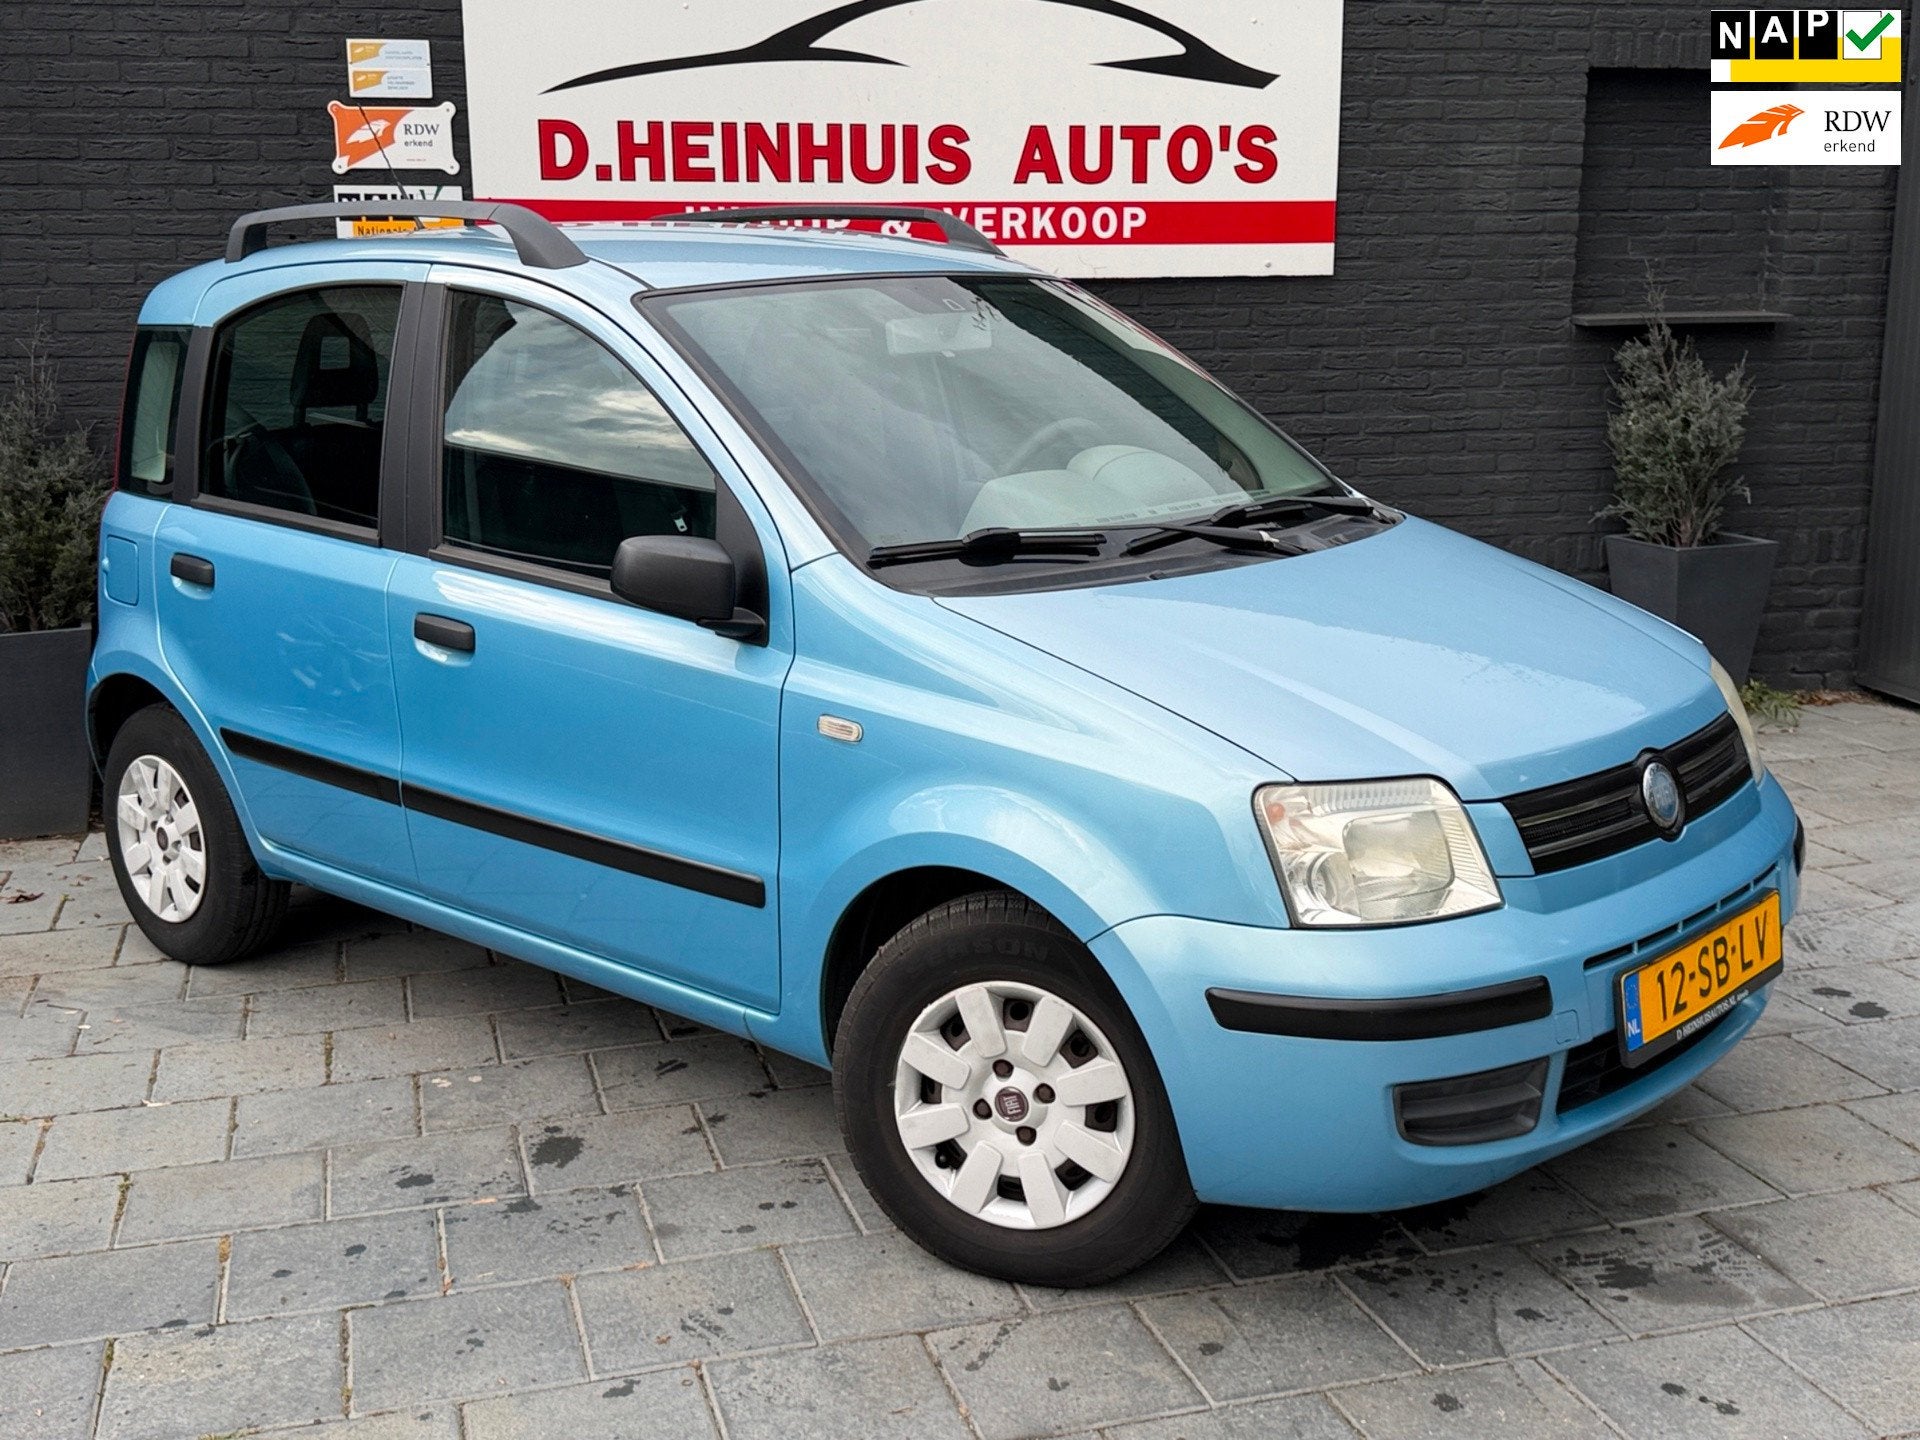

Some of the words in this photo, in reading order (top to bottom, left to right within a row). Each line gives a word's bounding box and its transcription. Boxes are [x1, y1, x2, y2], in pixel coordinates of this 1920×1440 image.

[403, 123, 440, 135] RDW
[404, 139, 434, 147] erkend
[537, 118, 972, 184] D.HEINHUIS
[1013, 124, 1279, 184] AUTO'S
[1656, 910, 1768, 1022] 12-SB-LV
[1626, 1019, 1641, 1038] NL
[1003, 1094, 1022, 1115] FIAT
